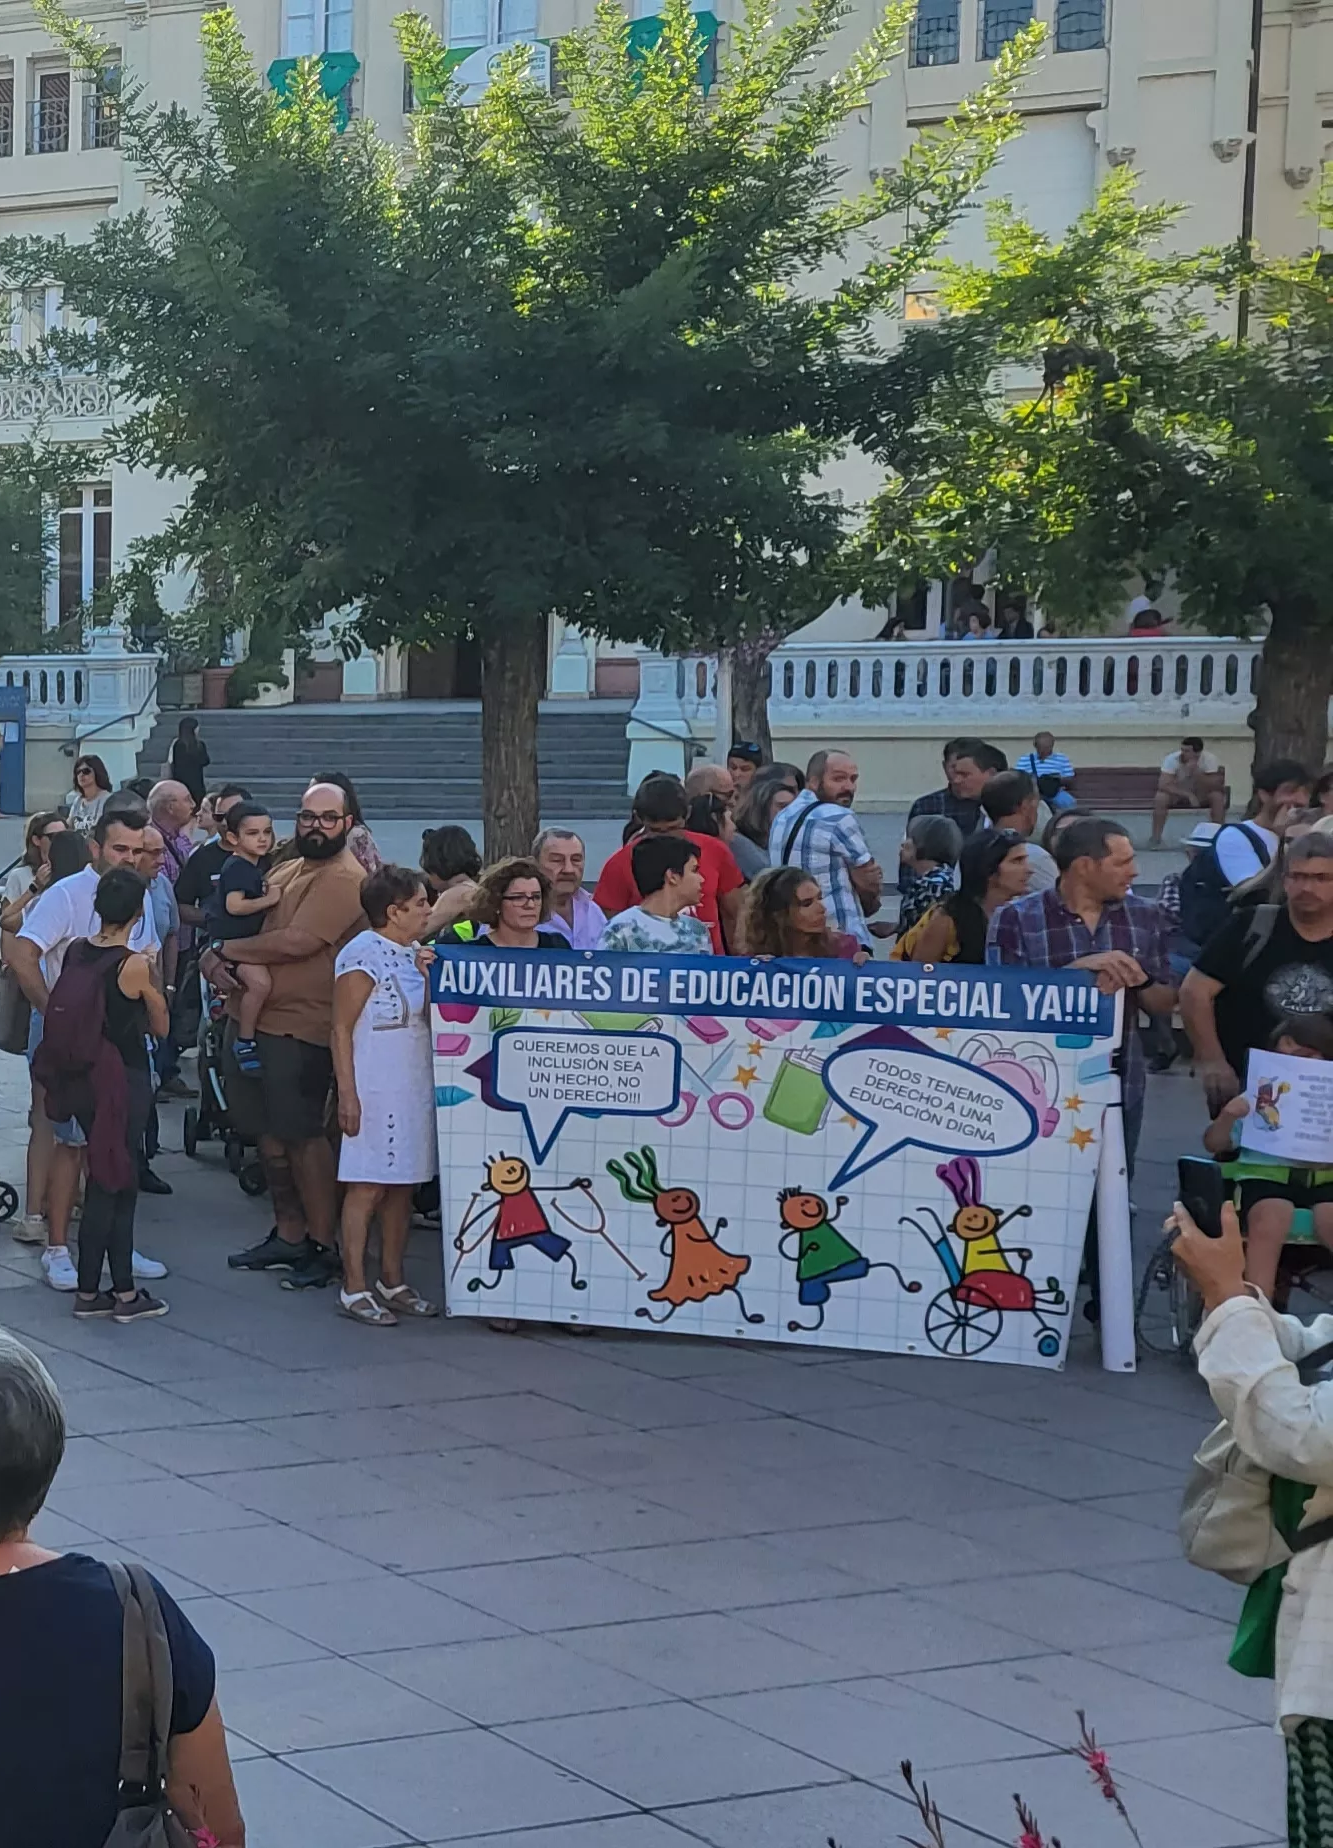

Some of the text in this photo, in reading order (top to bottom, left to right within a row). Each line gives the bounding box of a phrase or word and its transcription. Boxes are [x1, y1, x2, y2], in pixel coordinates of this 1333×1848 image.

[438, 960, 1099, 1024] AUXILIARES DE EDUCACIÓN ESPECIAL YA!!!
[513, 1039, 661, 1058] QUEREMOS QUE LA
[528, 1056, 644, 1073] INCLUSIÓN SEA
[528, 1087, 641, 1104] UN DERECHO!!!
[529, 1072, 641, 1088] UN HECHO, NO
[868, 1057, 1005, 1112] TODOS TENEMOS
[849, 1086, 997, 1144] EDUCACIÓN DIGNA
[865, 1074, 993, 1126] DERECHO A UNA
